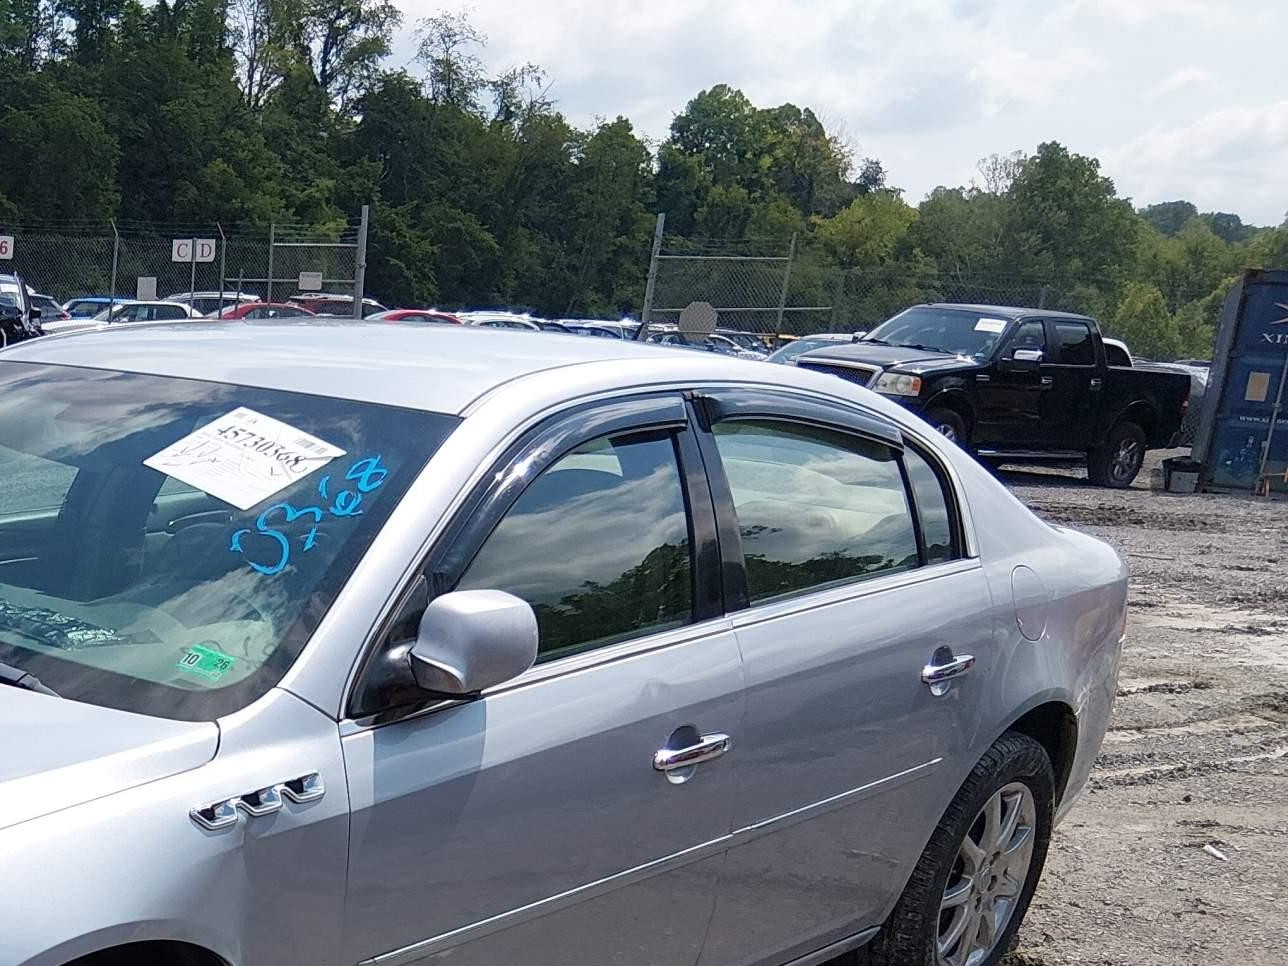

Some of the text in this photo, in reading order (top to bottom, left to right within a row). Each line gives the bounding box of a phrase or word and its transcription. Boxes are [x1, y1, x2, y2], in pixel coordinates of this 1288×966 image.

[0, 240, 9, 255] 6
[176, 243, 212, 258] C D
[217, 425, 307, 473] 45730368
[183, 652, 231, 670] 10 26
